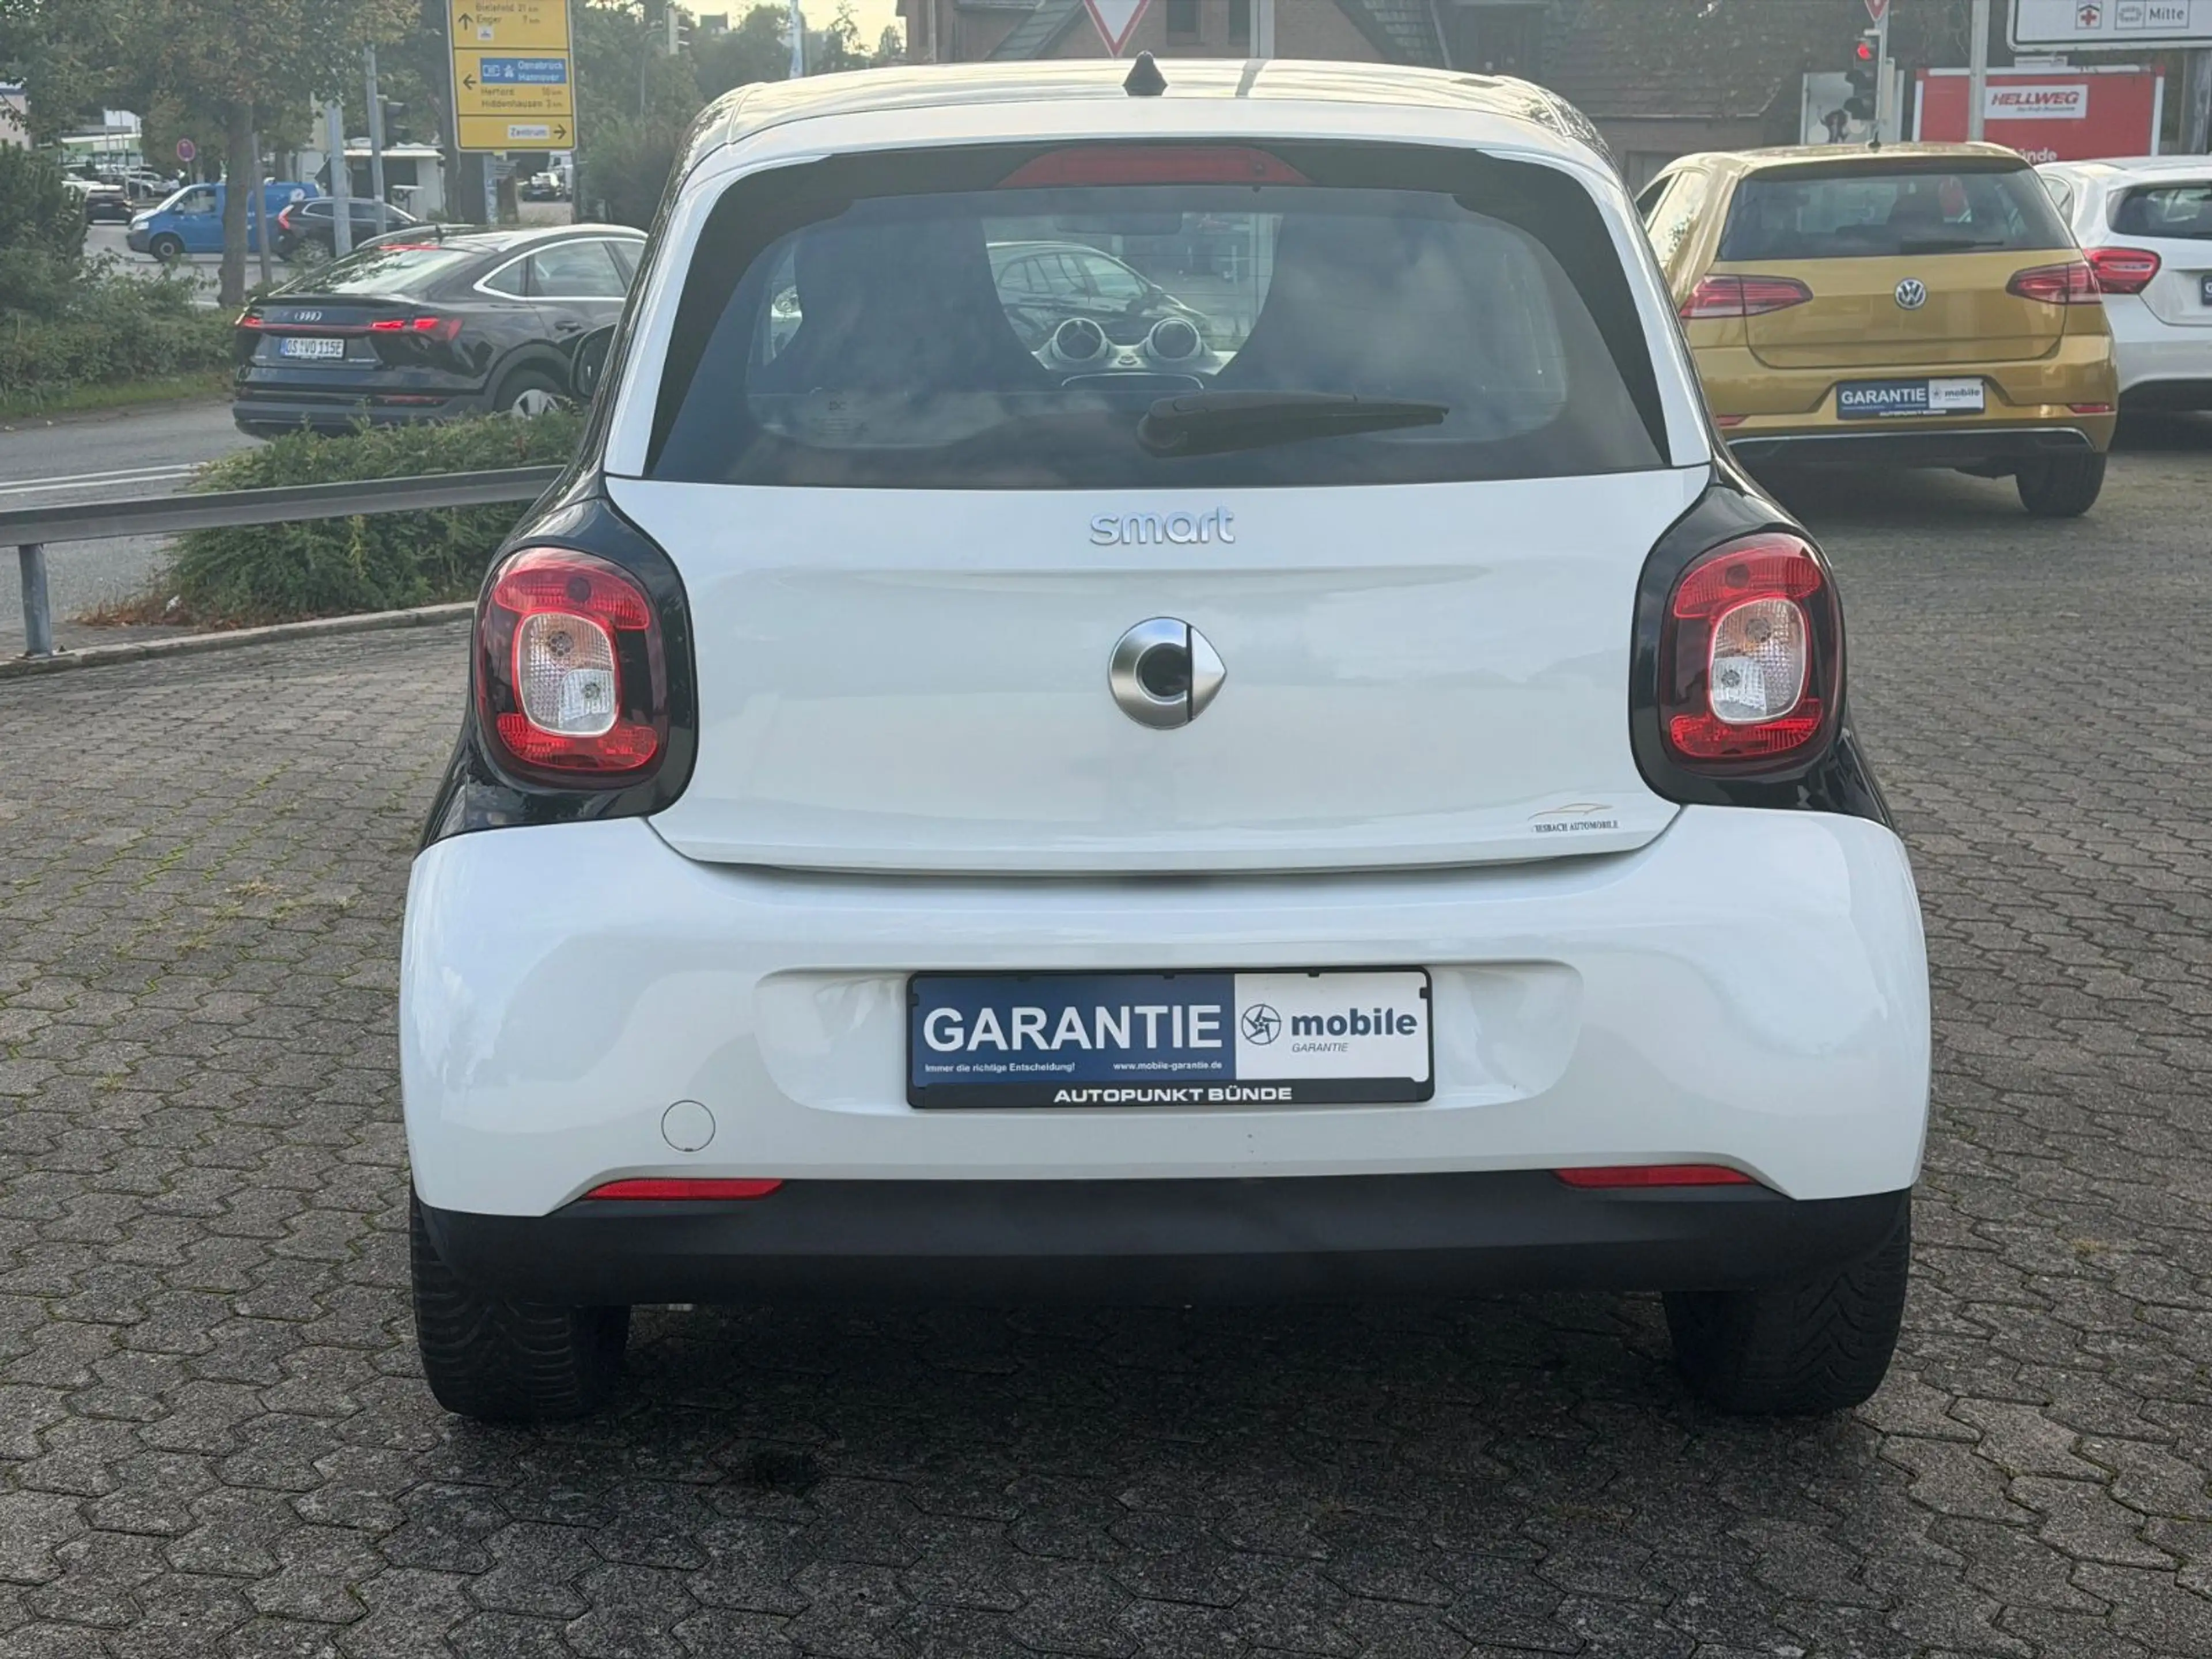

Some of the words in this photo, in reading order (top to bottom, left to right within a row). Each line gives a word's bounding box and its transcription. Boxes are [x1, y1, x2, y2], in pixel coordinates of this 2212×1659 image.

[476, 3, 514, 12] Bielefeld
[476, 14, 502, 24] Enger
[2149, 7, 2185, 21] Mitte
[518, 73, 559, 81] Hannover
[481, 88, 514, 96] Herford
[482, 99, 543, 108] Hiddenhausen
[1991, 91, 2080, 106] HELLWEG
[510, 127, 547, 137] Zentrum
[1841, 388, 1927, 404] GARANTIE
[1944, 387, 1980, 397] mobile
[1090, 506, 1235, 545] smart
[1291, 1008, 1417, 1036] mobile
[923, 1005, 1222, 1051] GARANTIE
[1292, 1043, 1349, 1052] GARANTIE
[925, 1063, 953, 1072] Immer
[956, 1063, 970, 1072] die
[973, 1063, 1007, 1073] richtige
[1009, 1062, 1075, 1073] Entscheidung!
[1113, 1061, 1222, 1071] www.mobile-garantie.de
[1053, 1088, 1203, 1103] AUTOPUNKT
[1209, 1085, 1292, 1101] BÜNDE
